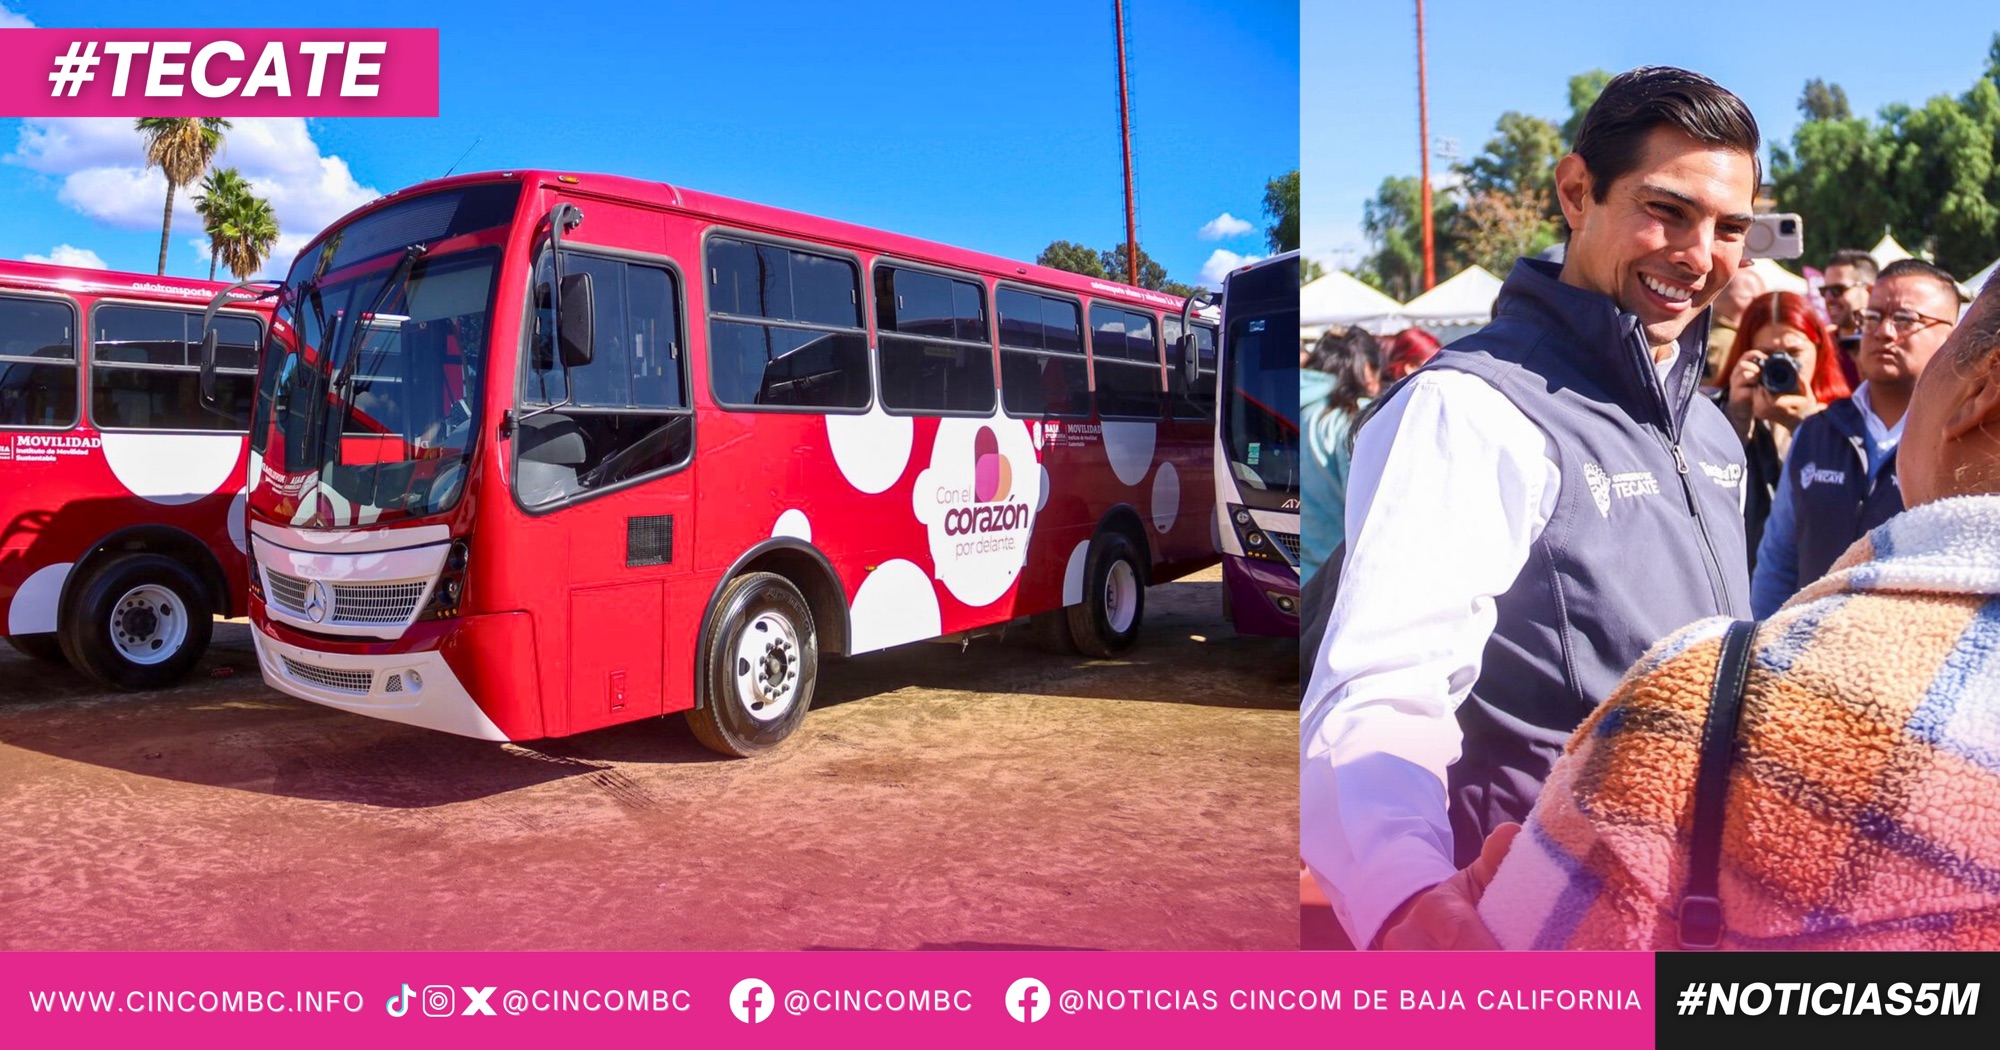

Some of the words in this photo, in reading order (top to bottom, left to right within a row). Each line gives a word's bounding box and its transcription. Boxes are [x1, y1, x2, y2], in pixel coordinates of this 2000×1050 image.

[132, 282, 212, 297] autotransporte
[1067, 424, 1101, 434] MOVILIDAD
[17, 435, 101, 448] MOVILIDAD
[16, 447, 45, 455] Instituto
[56, 448, 89, 456] Movilidad
[16, 454, 57, 462] Sustentable
[936, 486, 960, 504] Con
[961, 484, 971, 503] el
[1611, 479, 1660, 499] TECATE
[944, 494, 1029, 537] corazón
[955, 541, 975, 561] por
